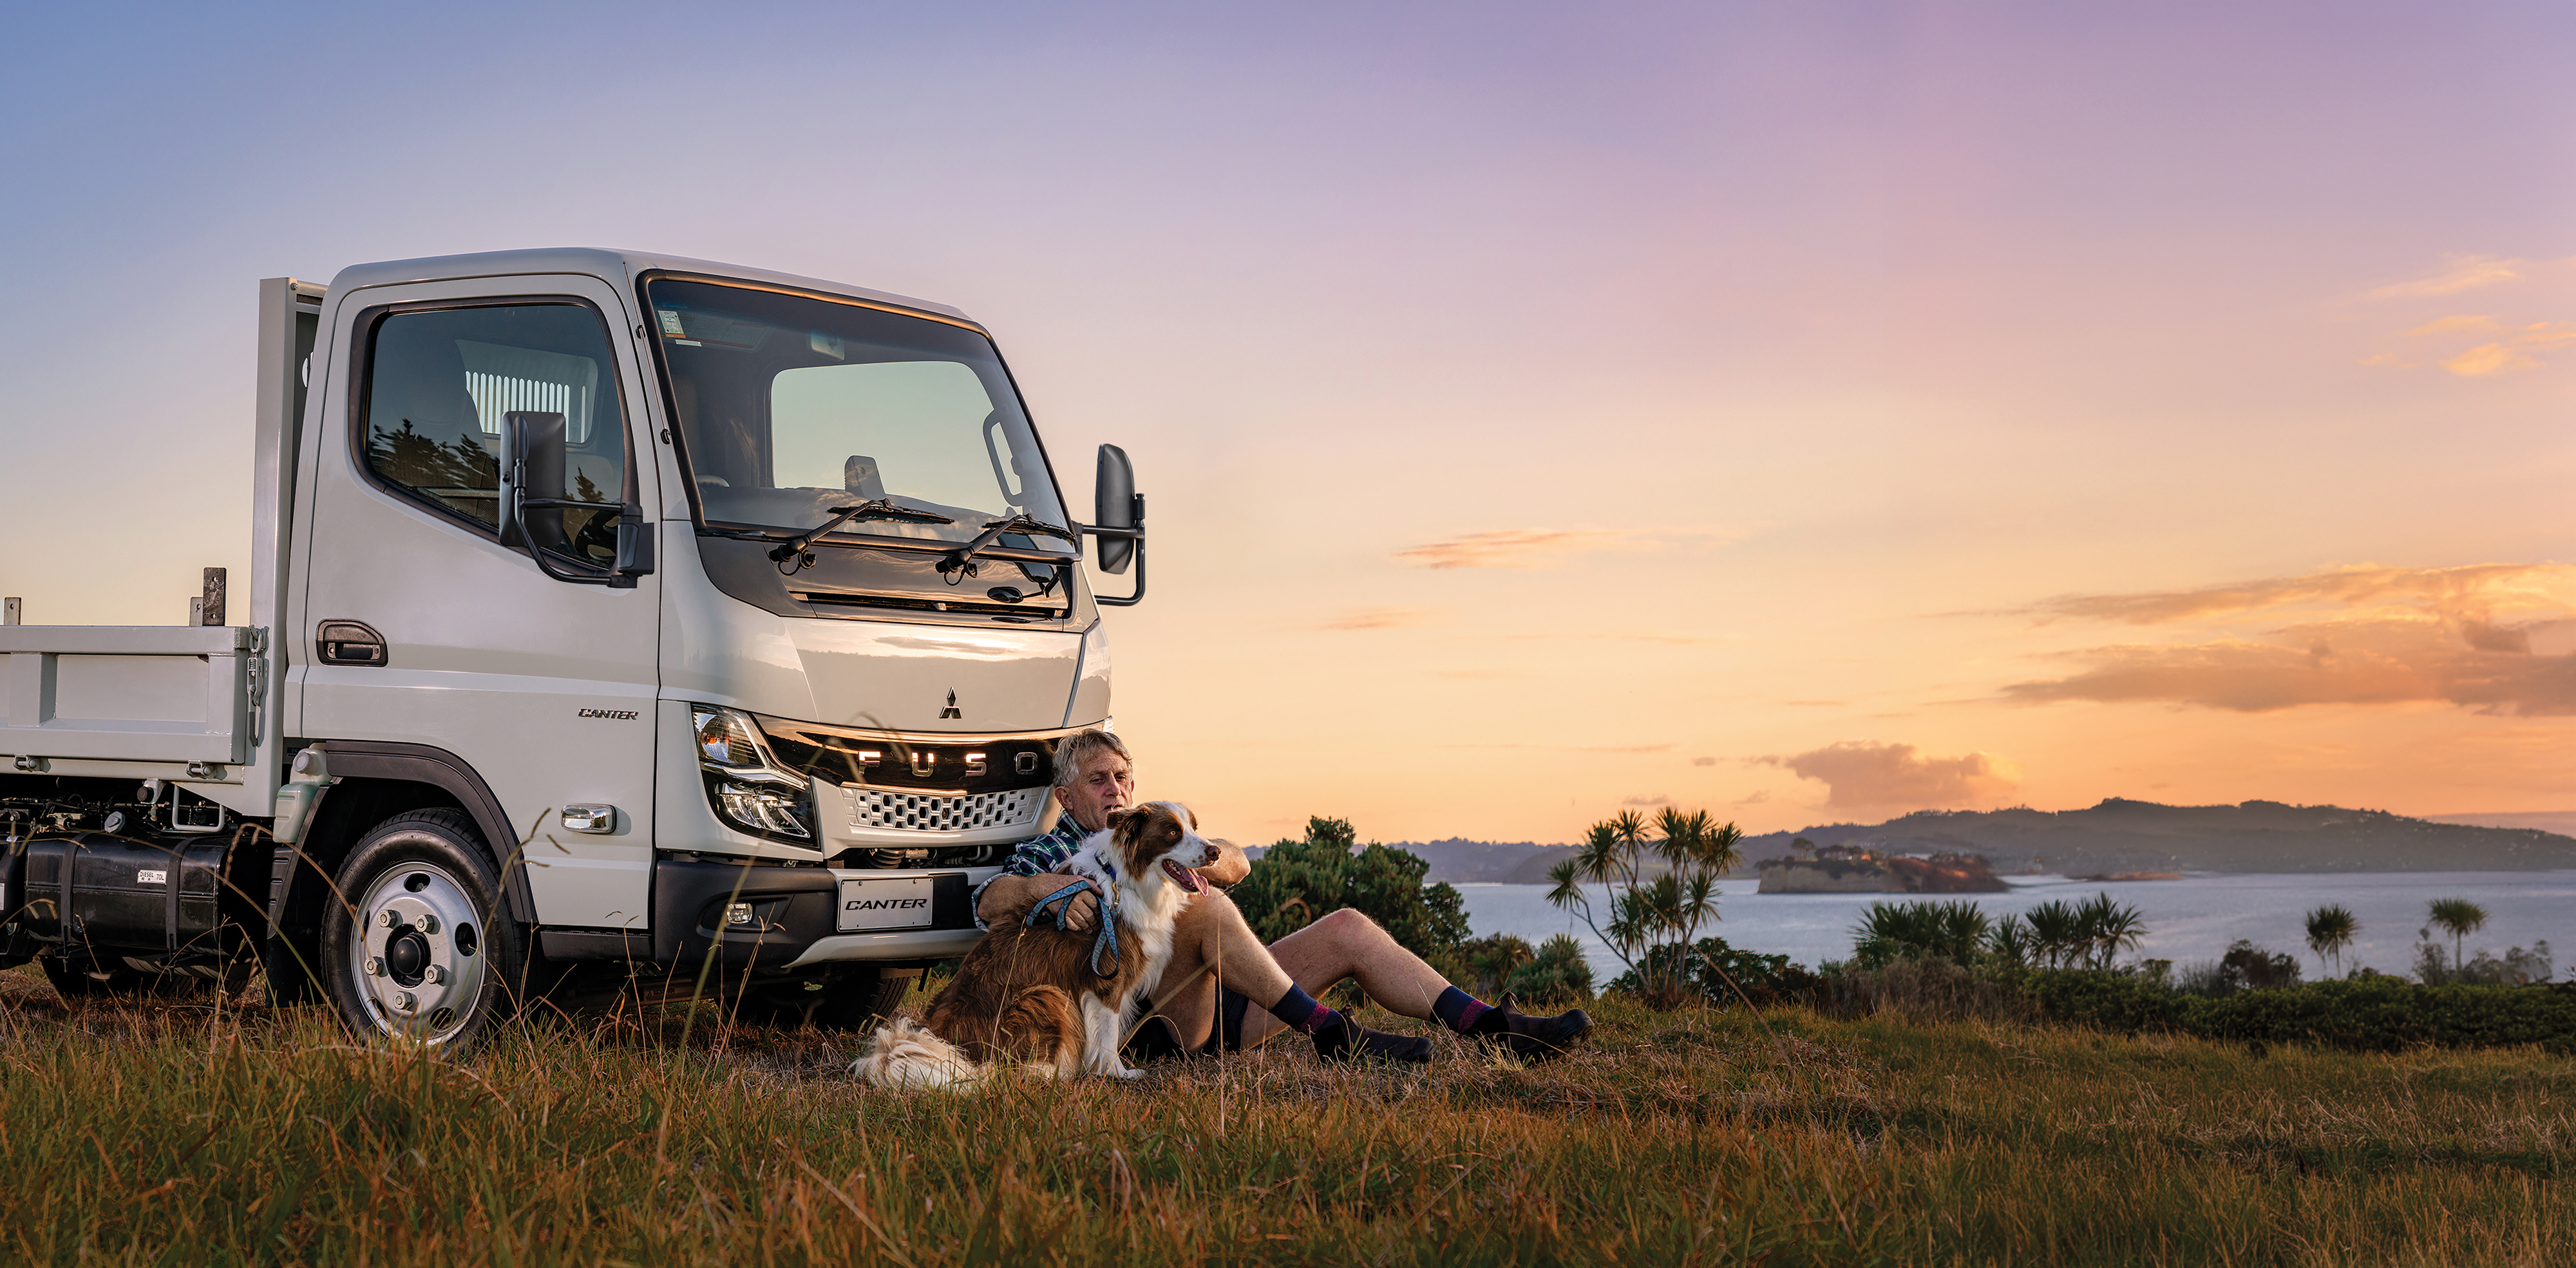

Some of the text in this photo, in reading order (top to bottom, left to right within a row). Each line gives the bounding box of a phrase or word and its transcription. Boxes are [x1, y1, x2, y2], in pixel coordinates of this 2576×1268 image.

[578, 708, 638, 720] CANTER
[858, 751, 1038, 777] FUSO
[332, 849, 377, 919] YOOHAMA
[845, 898, 927, 910] CANTER
